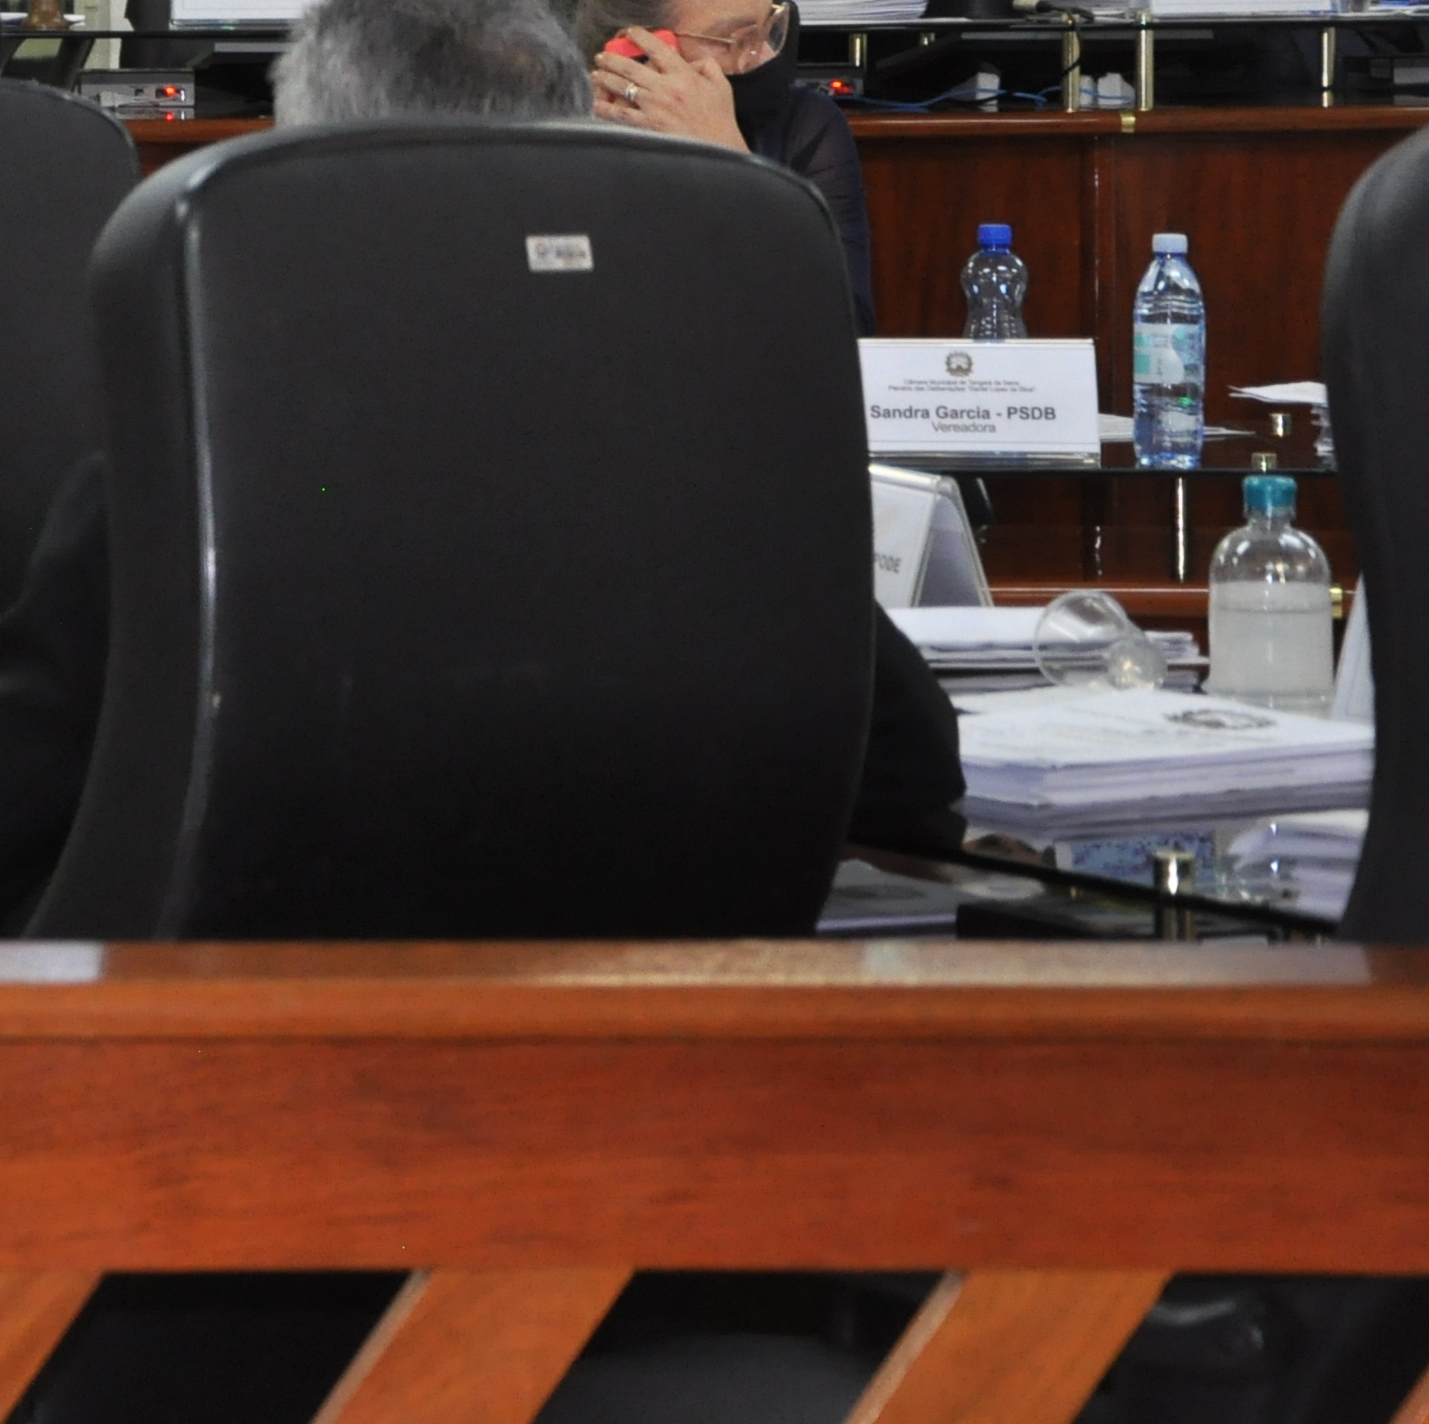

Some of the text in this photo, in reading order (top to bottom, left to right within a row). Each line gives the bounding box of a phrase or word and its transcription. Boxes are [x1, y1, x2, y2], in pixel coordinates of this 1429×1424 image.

[870, 404, 931, 420] Sandra
[935, 405, 991, 421] Garcia
[1007, 406, 1057, 421] PSDB
[931, 422, 997, 434] Vereadora
